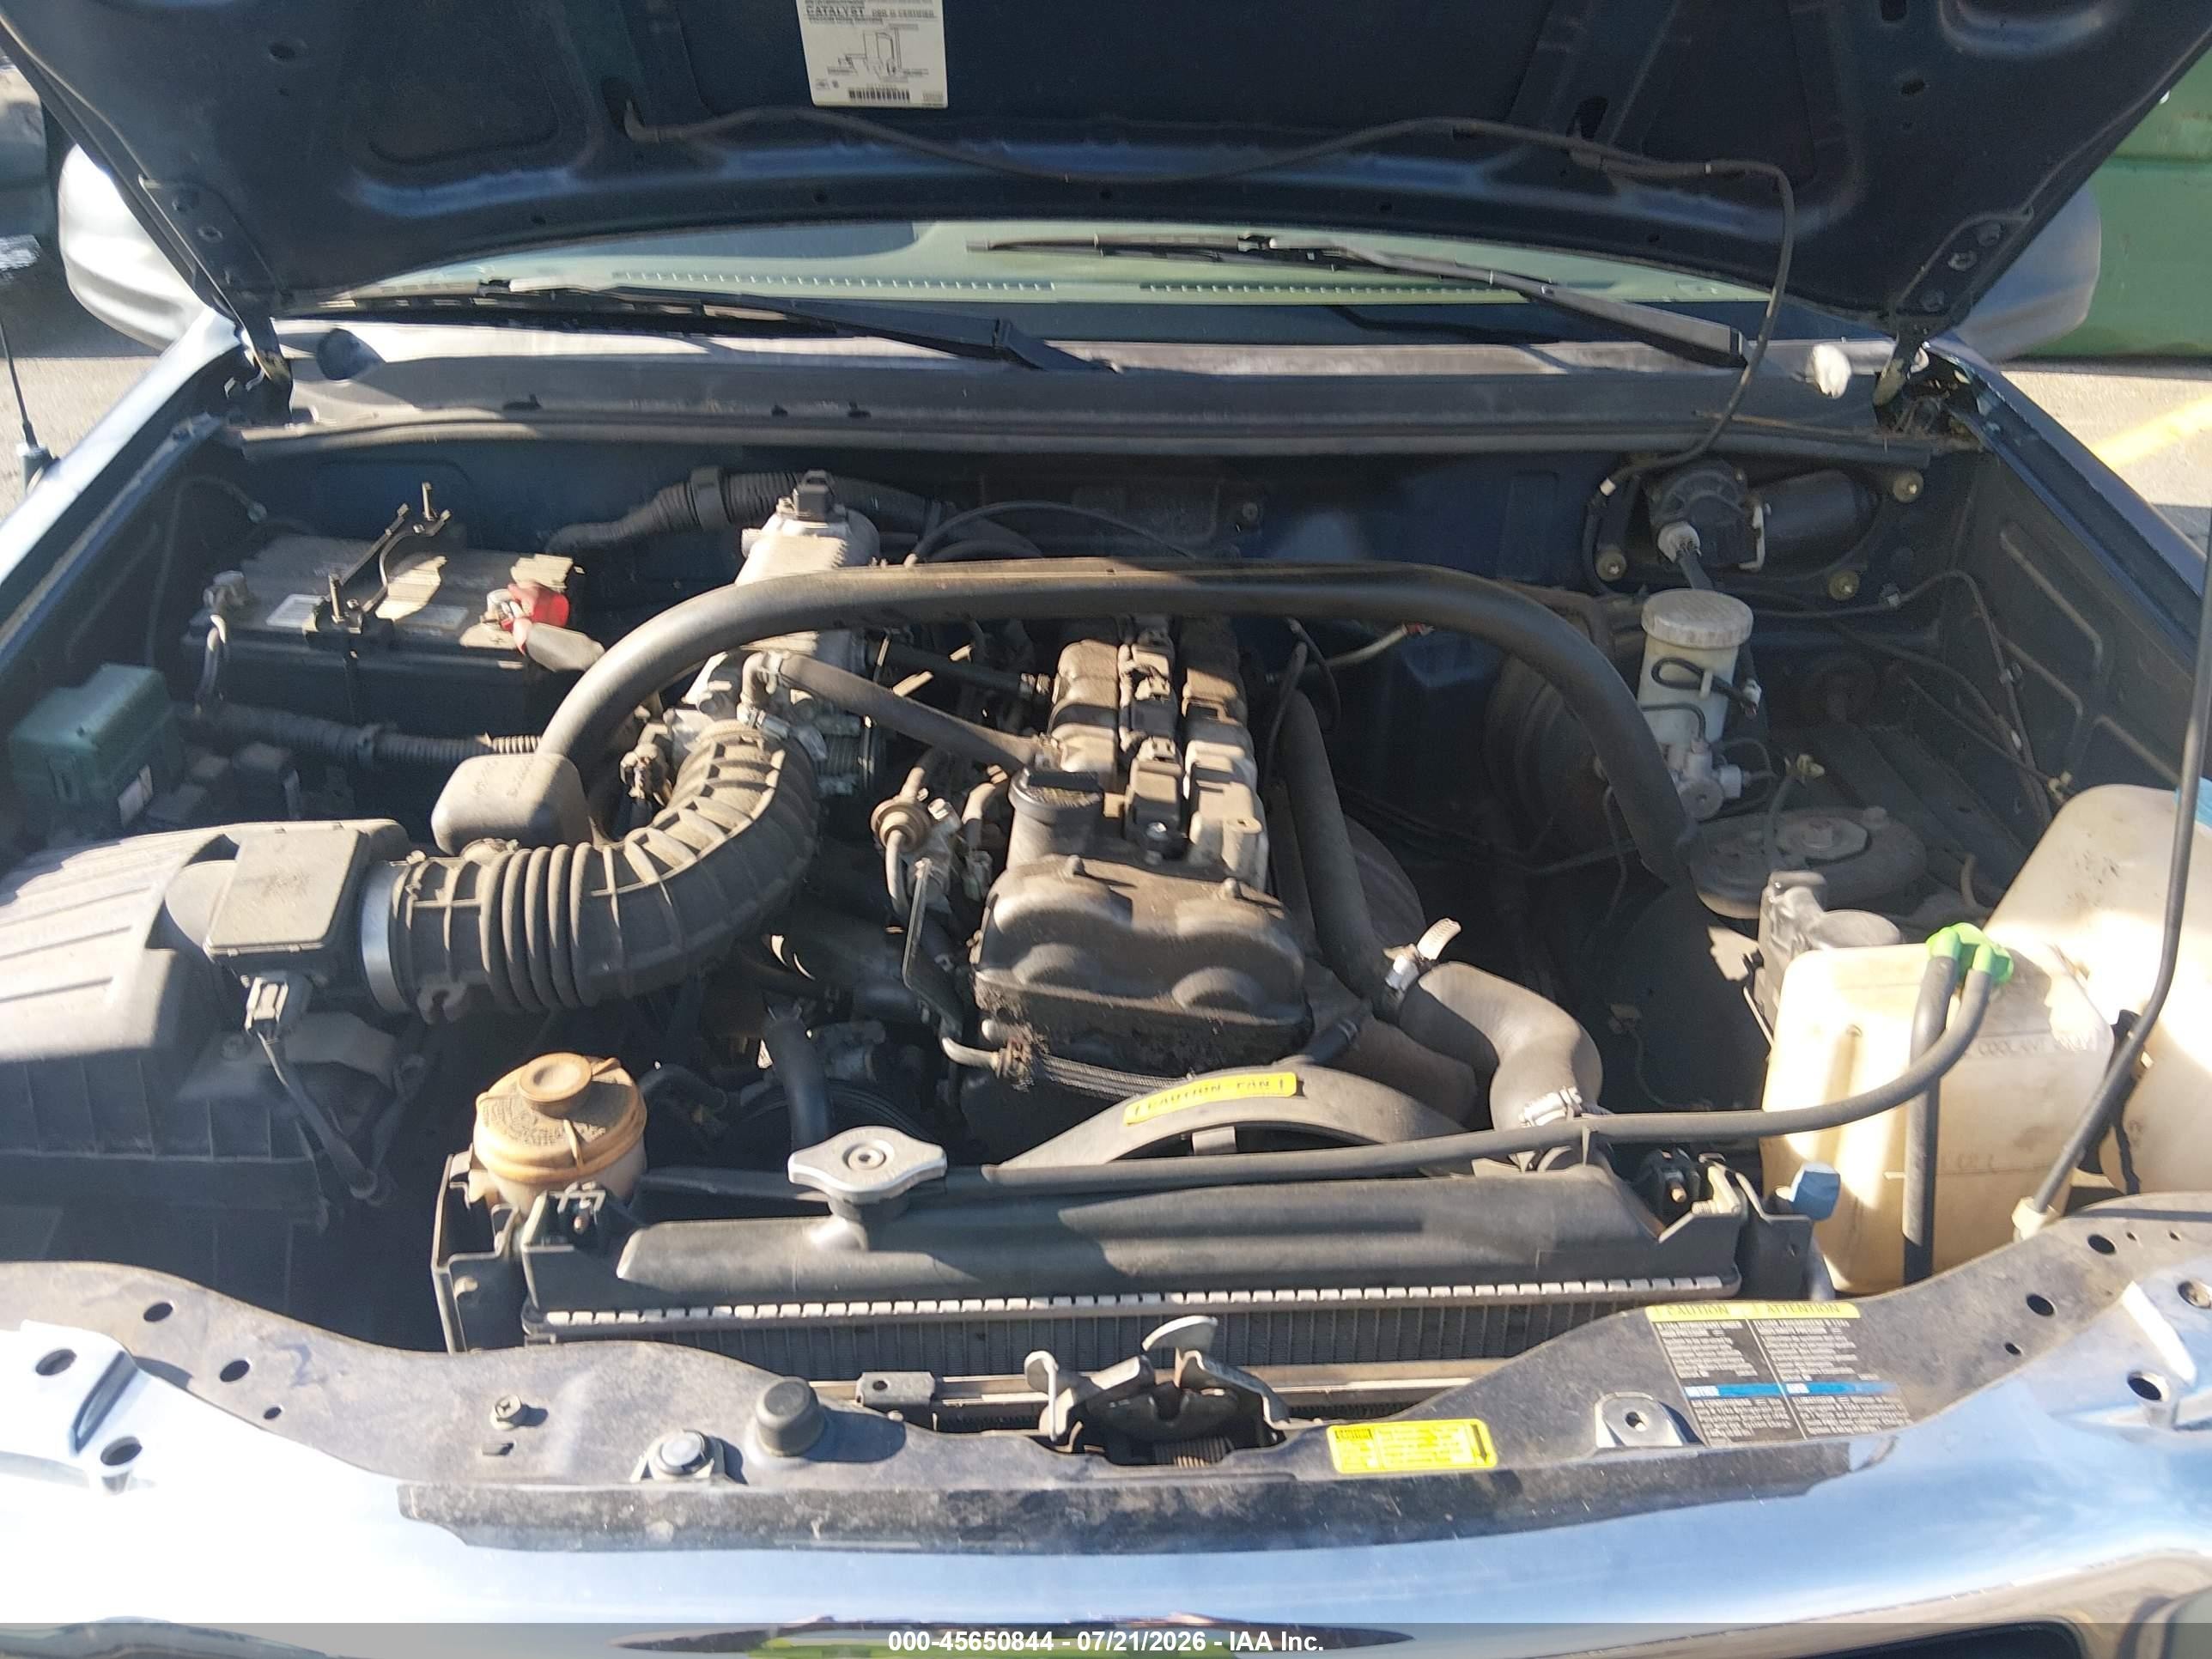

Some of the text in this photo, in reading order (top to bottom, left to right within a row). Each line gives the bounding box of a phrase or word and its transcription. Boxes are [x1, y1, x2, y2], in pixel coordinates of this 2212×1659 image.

[805, 5, 865, 15] CATALYST
[1667, 1304, 1730, 1316] CAUTION
[1767, 1304, 1841, 1314] ATTENTION
